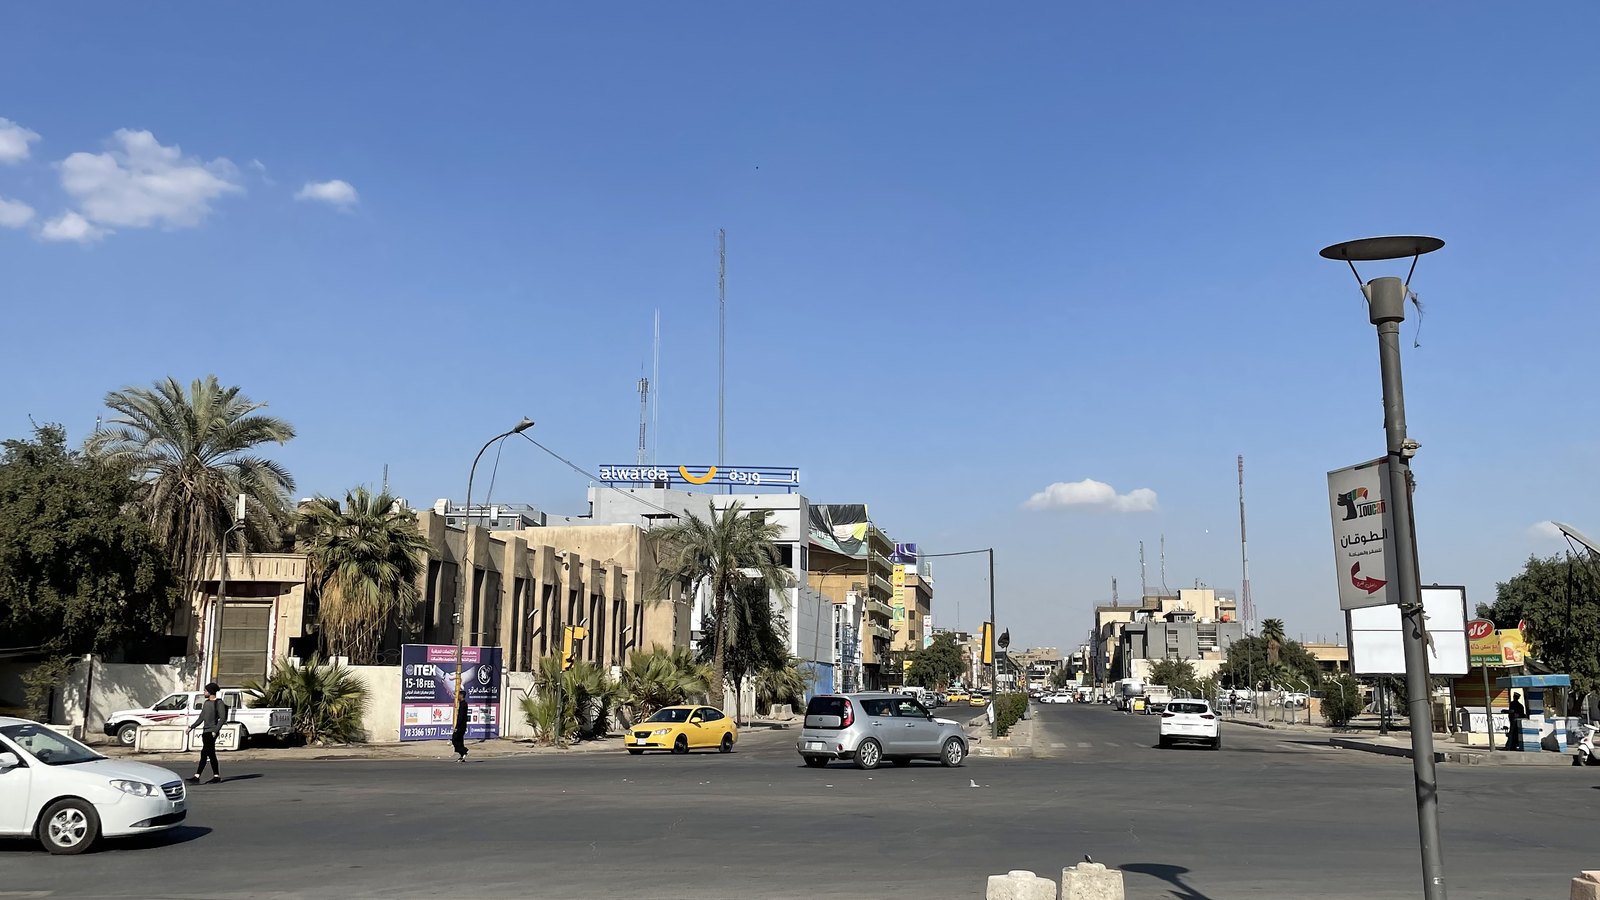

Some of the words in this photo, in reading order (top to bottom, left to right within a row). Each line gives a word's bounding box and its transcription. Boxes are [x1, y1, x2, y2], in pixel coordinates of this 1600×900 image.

[600, 466, 669, 481] alwarda
[1356, 499, 1386, 518] Toucan
[1340, 528, 1388, 549] الطوقان
[414, 664, 436, 676] ITEX
[405, 678, 424, 689] 15-18
